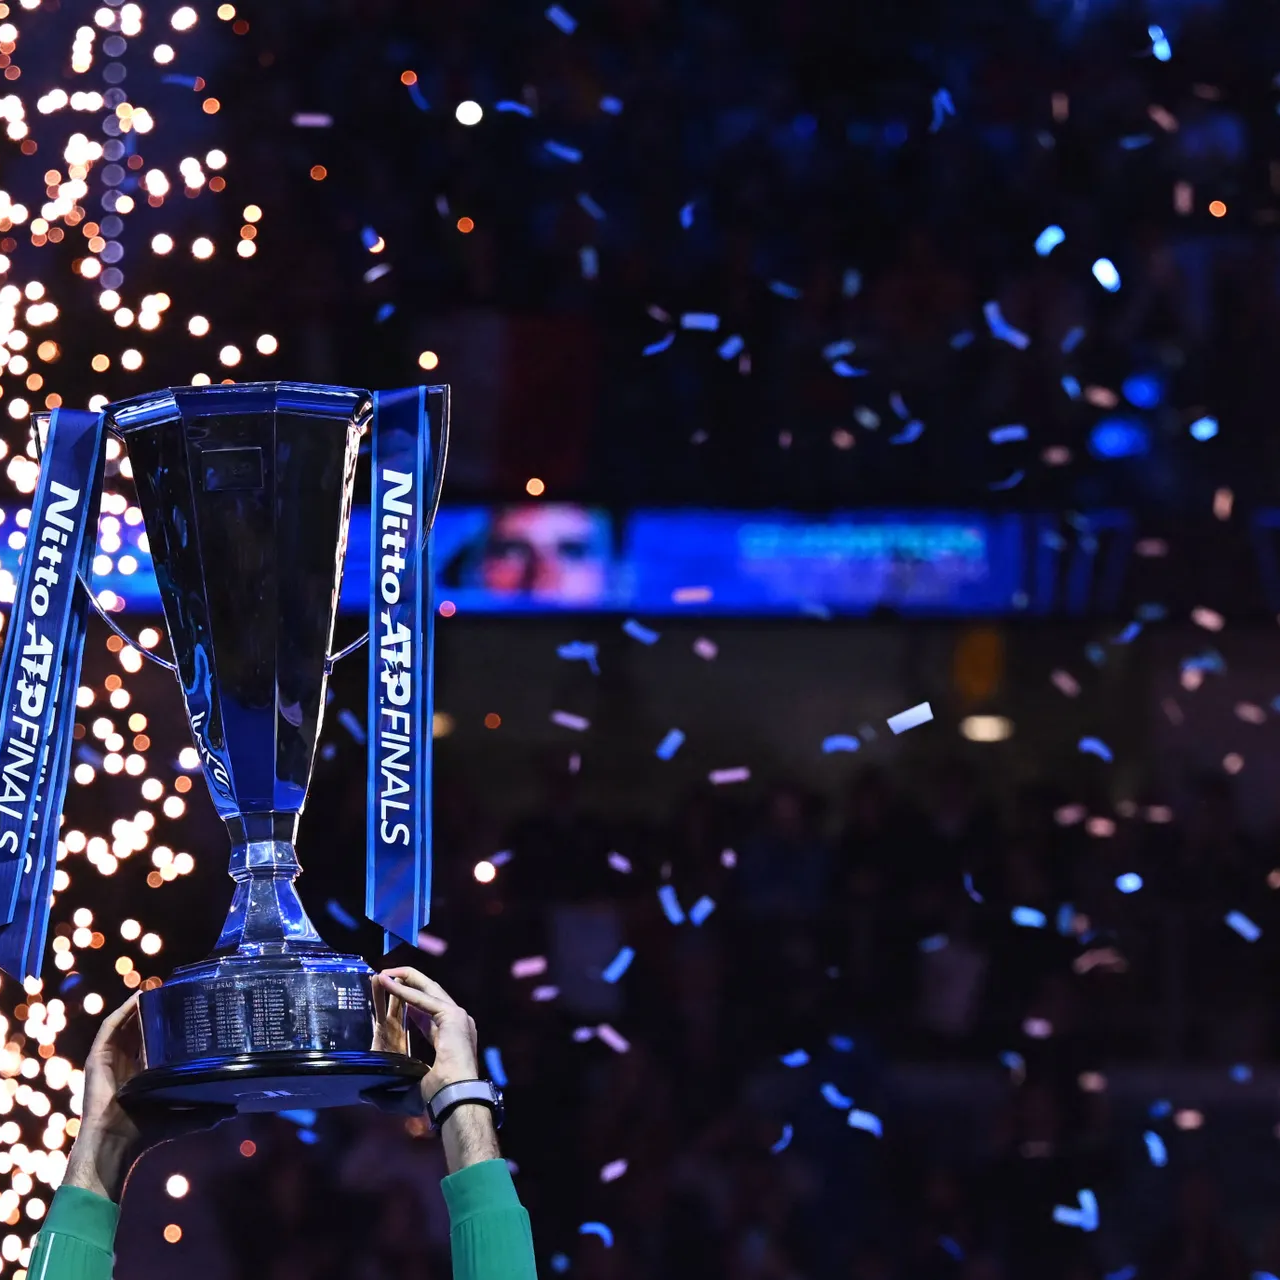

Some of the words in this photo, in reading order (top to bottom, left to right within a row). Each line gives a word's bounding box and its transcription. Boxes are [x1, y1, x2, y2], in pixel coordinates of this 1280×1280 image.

[30, 480, 81, 617] Nitto
[380, 469, 413, 605] Nitto
[16, 619, 54, 718] ATP
[380, 607, 411, 706] ATP
[380, 707, 410, 847] FINALS
